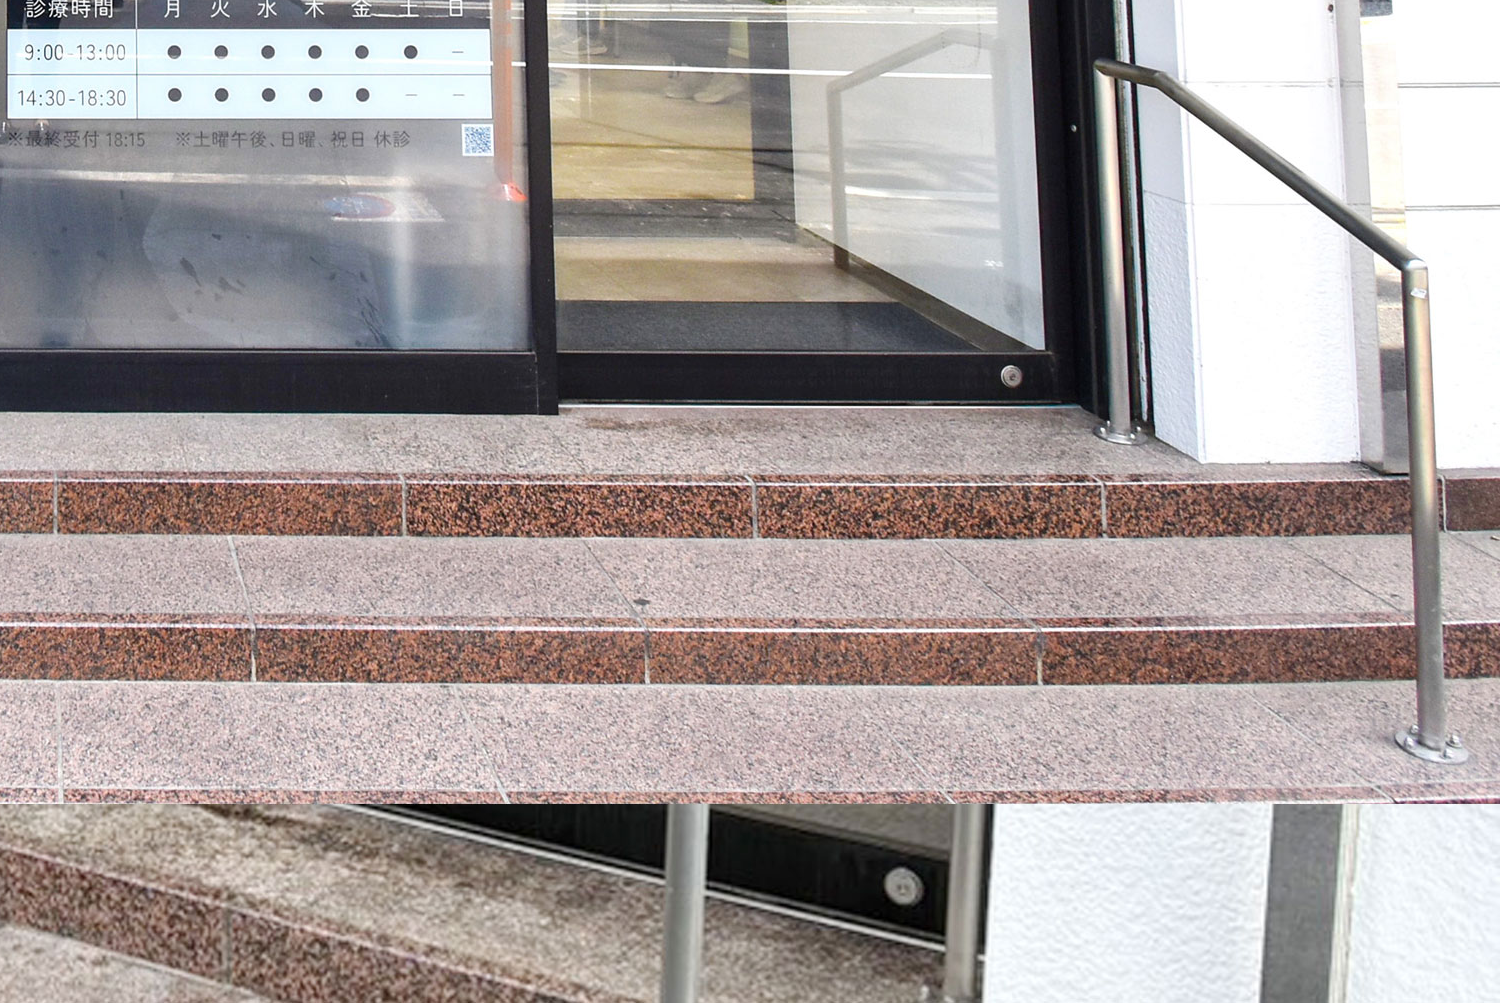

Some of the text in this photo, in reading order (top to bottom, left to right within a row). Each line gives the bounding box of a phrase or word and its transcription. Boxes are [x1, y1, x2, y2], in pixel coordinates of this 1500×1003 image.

[449, 0, 464, 17] 日
[24, 44, 126, 61] 9:00-13:00
[17, 90, 127, 107] 14:30-18:30
[107, 132, 145, 147] 18:15
[373, 131, 411, 147] 休診
